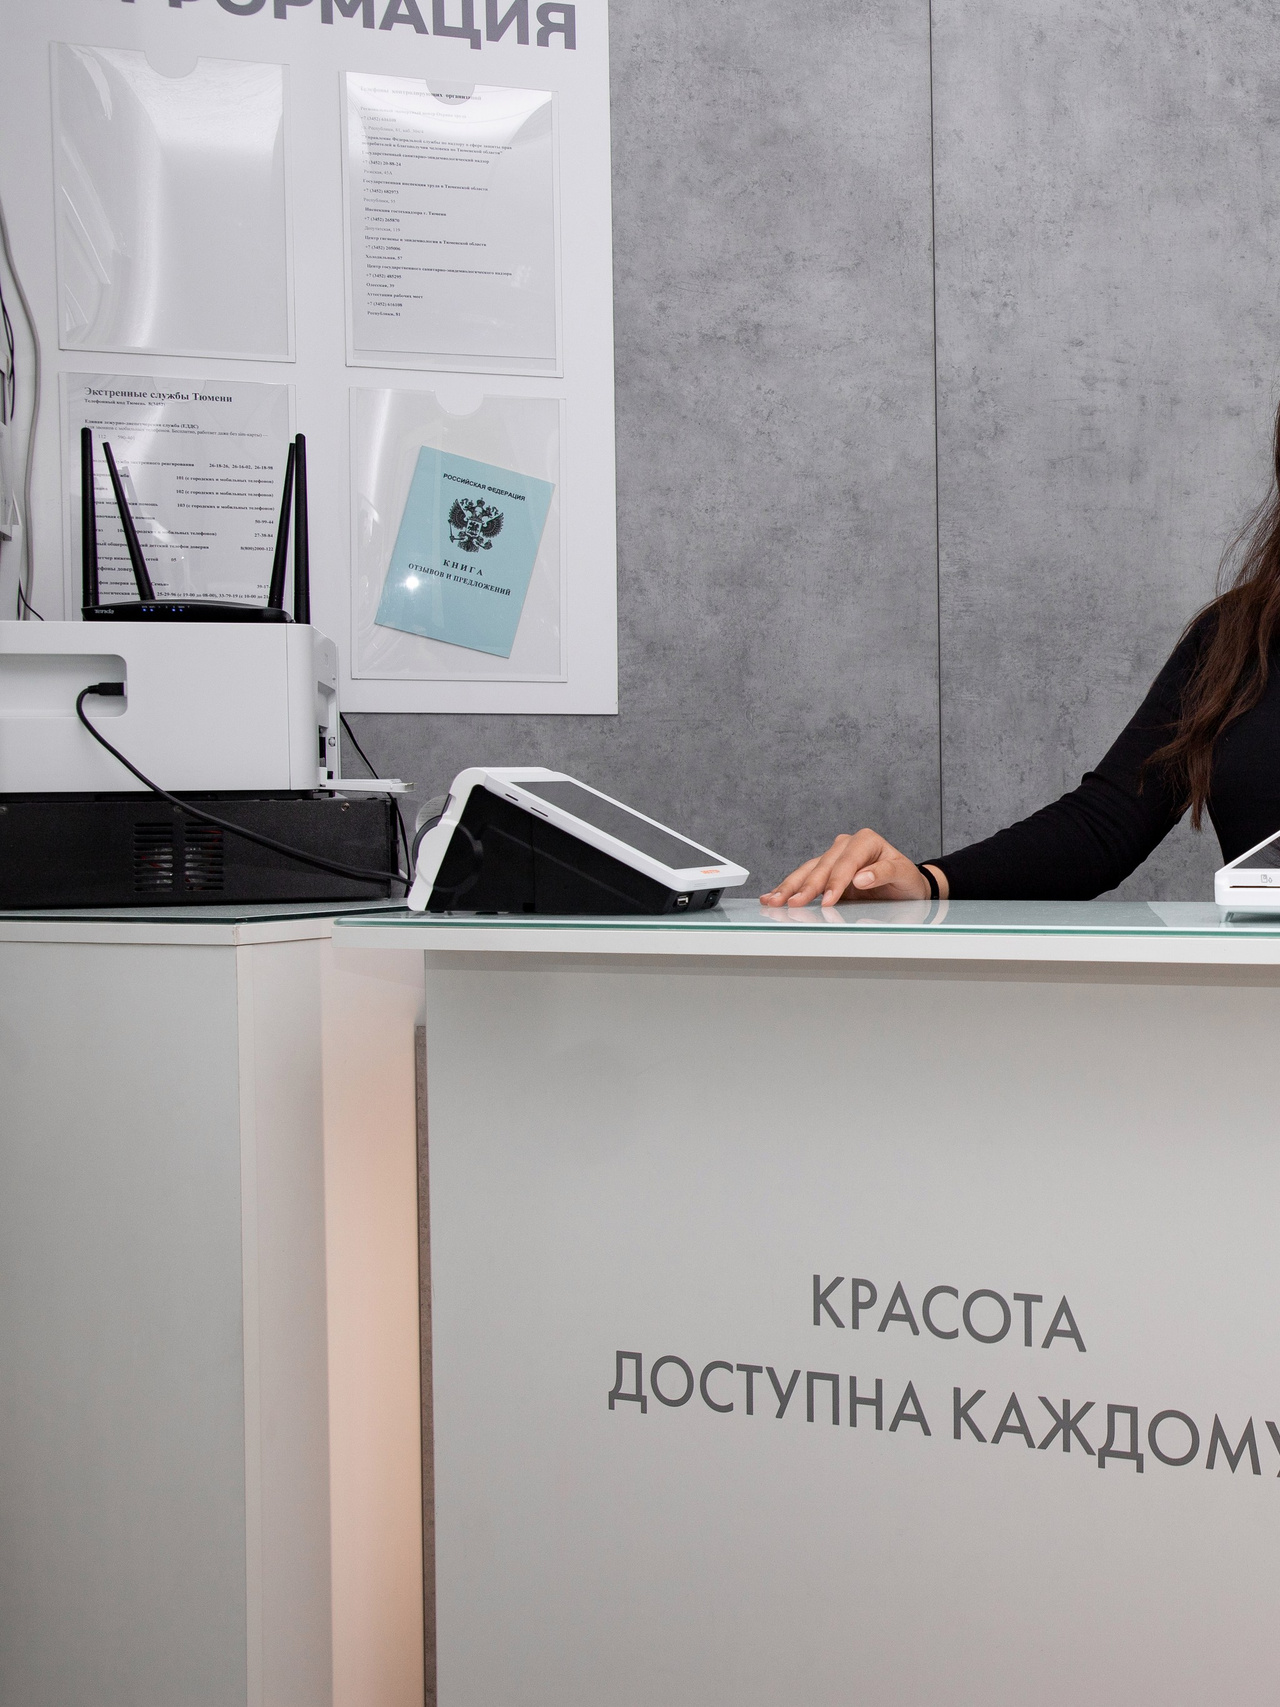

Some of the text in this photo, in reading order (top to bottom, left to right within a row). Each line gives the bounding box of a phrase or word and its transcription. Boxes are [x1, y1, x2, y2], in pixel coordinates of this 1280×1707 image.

[84, 387, 233, 403] Экстренные службы Тюмени
[443, 473, 526, 501] РОССИЙСКАЯ ФЕДЕРАЦИЯ
[408, 563, 445, 577] ОТЗЫВОВ
[453, 575, 511, 596] ПРЕДЛОЖЕНИЙ
[443, 559, 483, 576] КНИГА
[813, 1274, 1087, 1353] КРАСОТА
[608, 1349, 932, 1437] ДОСТУПНА
